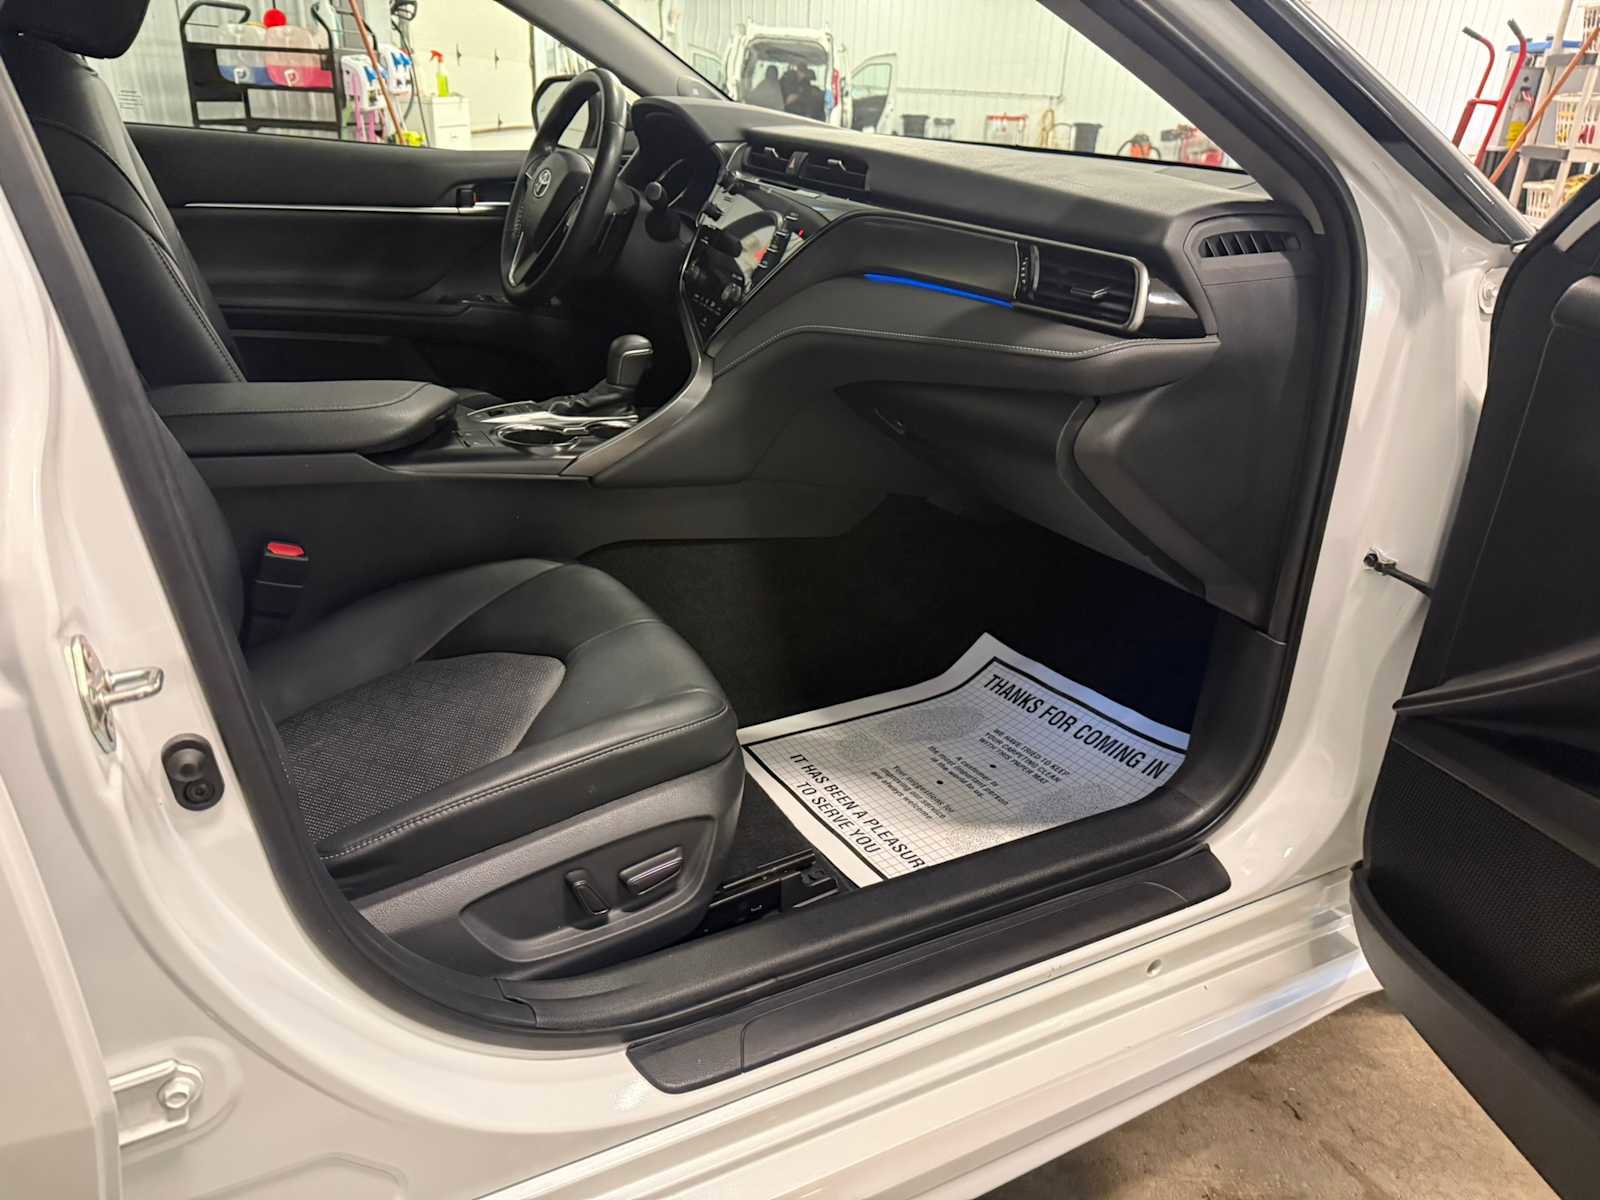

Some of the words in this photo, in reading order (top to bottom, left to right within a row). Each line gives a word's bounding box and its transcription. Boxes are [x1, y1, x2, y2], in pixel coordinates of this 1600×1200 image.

[984, 673, 1044, 714] THANKS
[1038, 705, 1078, 732] FOR
[1073, 724, 1147, 769] COMING
[1142, 757, 1171, 780] IN
[1001, 744, 1039, 769] CARPETING
[1037, 766, 1061, 783] CLEAN
[1010, 759, 1034, 775] PAPER
[1032, 772, 1049, 785] MAT
[1021, 745, 1042, 760] TRIED
[1040, 758, 1052, 766] TO
[1050, 764, 1071, 776] KEEP
[790, 753, 809, 763] IT
[801, 764, 829, 784] HAS
[824, 784, 860, 810] BEEN
[852, 810, 868, 819] A
[863, 818, 927, 869] PLEASUR
[796, 782, 817, 796] TO
[811, 796, 855, 829] SERVE
[849, 829, 881, 854] YOU
